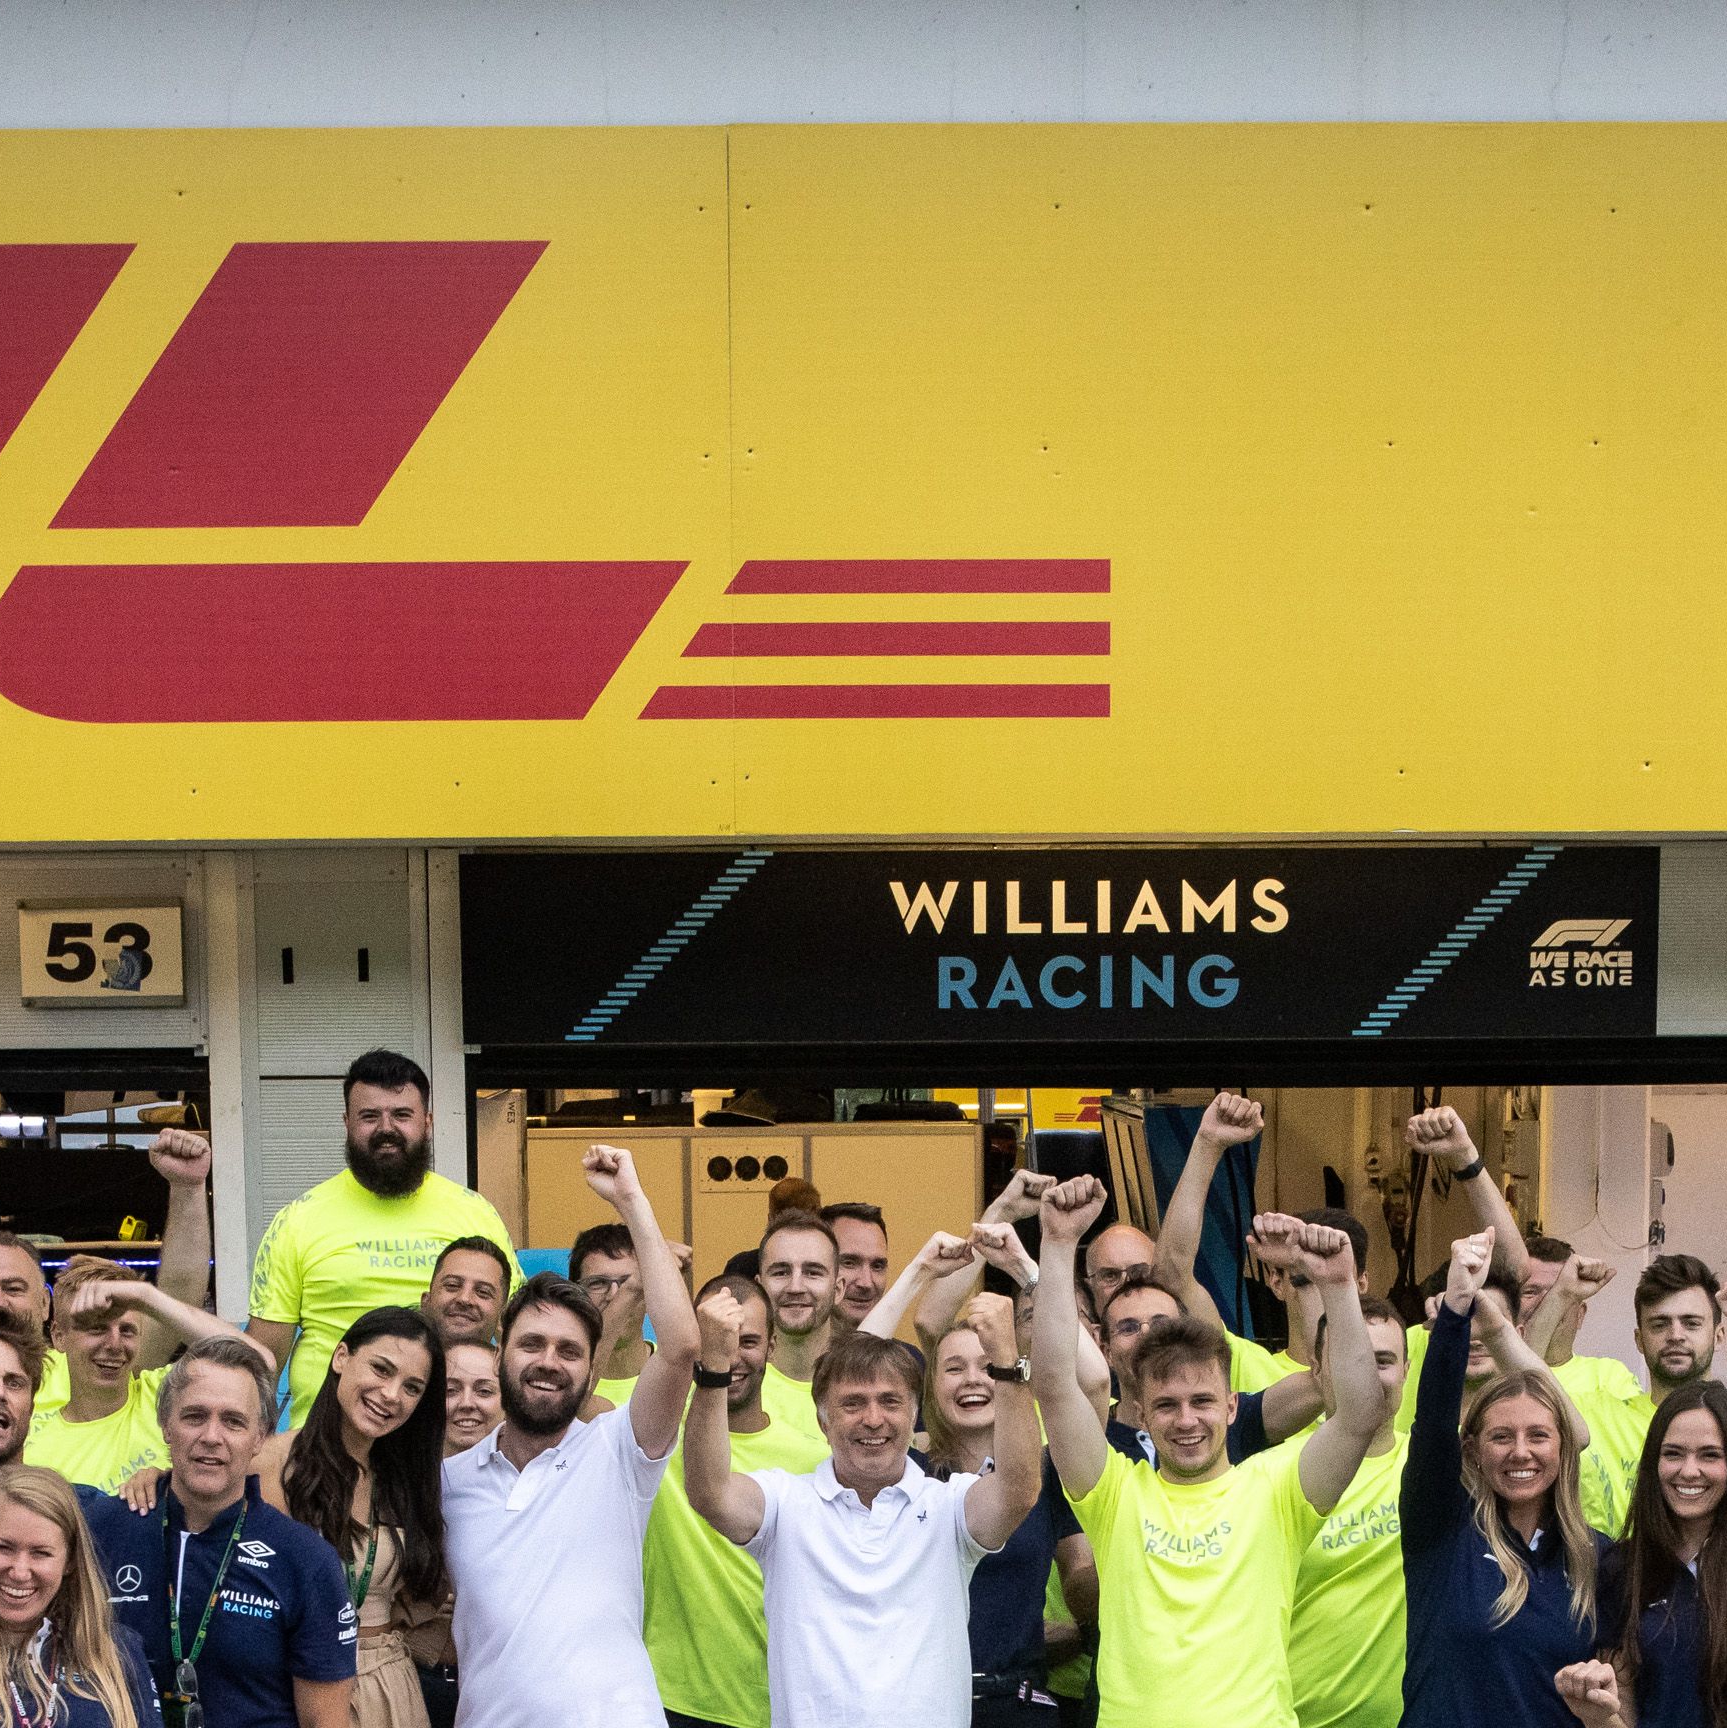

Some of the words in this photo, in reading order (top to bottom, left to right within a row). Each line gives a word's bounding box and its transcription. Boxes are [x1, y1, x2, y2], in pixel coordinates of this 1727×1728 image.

[889, 878, 1289, 935] WILLIAMS
[44, 922, 153, 984] 53
[1531, 951, 1569, 968] WE
[1573, 951, 1633, 968] RACE
[938, 954, 1240, 1010] RACING
[1529, 969, 1566, 987] AS
[1574, 969, 1633, 987] ONE
[355, 1239, 448, 1254] WILLIAMS
[1328, 1500, 1397, 1531] ILLIAM
[1143, 1519, 1232, 1553] WILLIAMS
[1321, 1519, 1401, 1551] RACING
[237, 1555, 269, 1569] umbro
[1144, 1540, 1222, 1564] RAING
[219, 1589, 281, 1610] WILLIAMS
[222, 1601, 274, 1619] RACING
